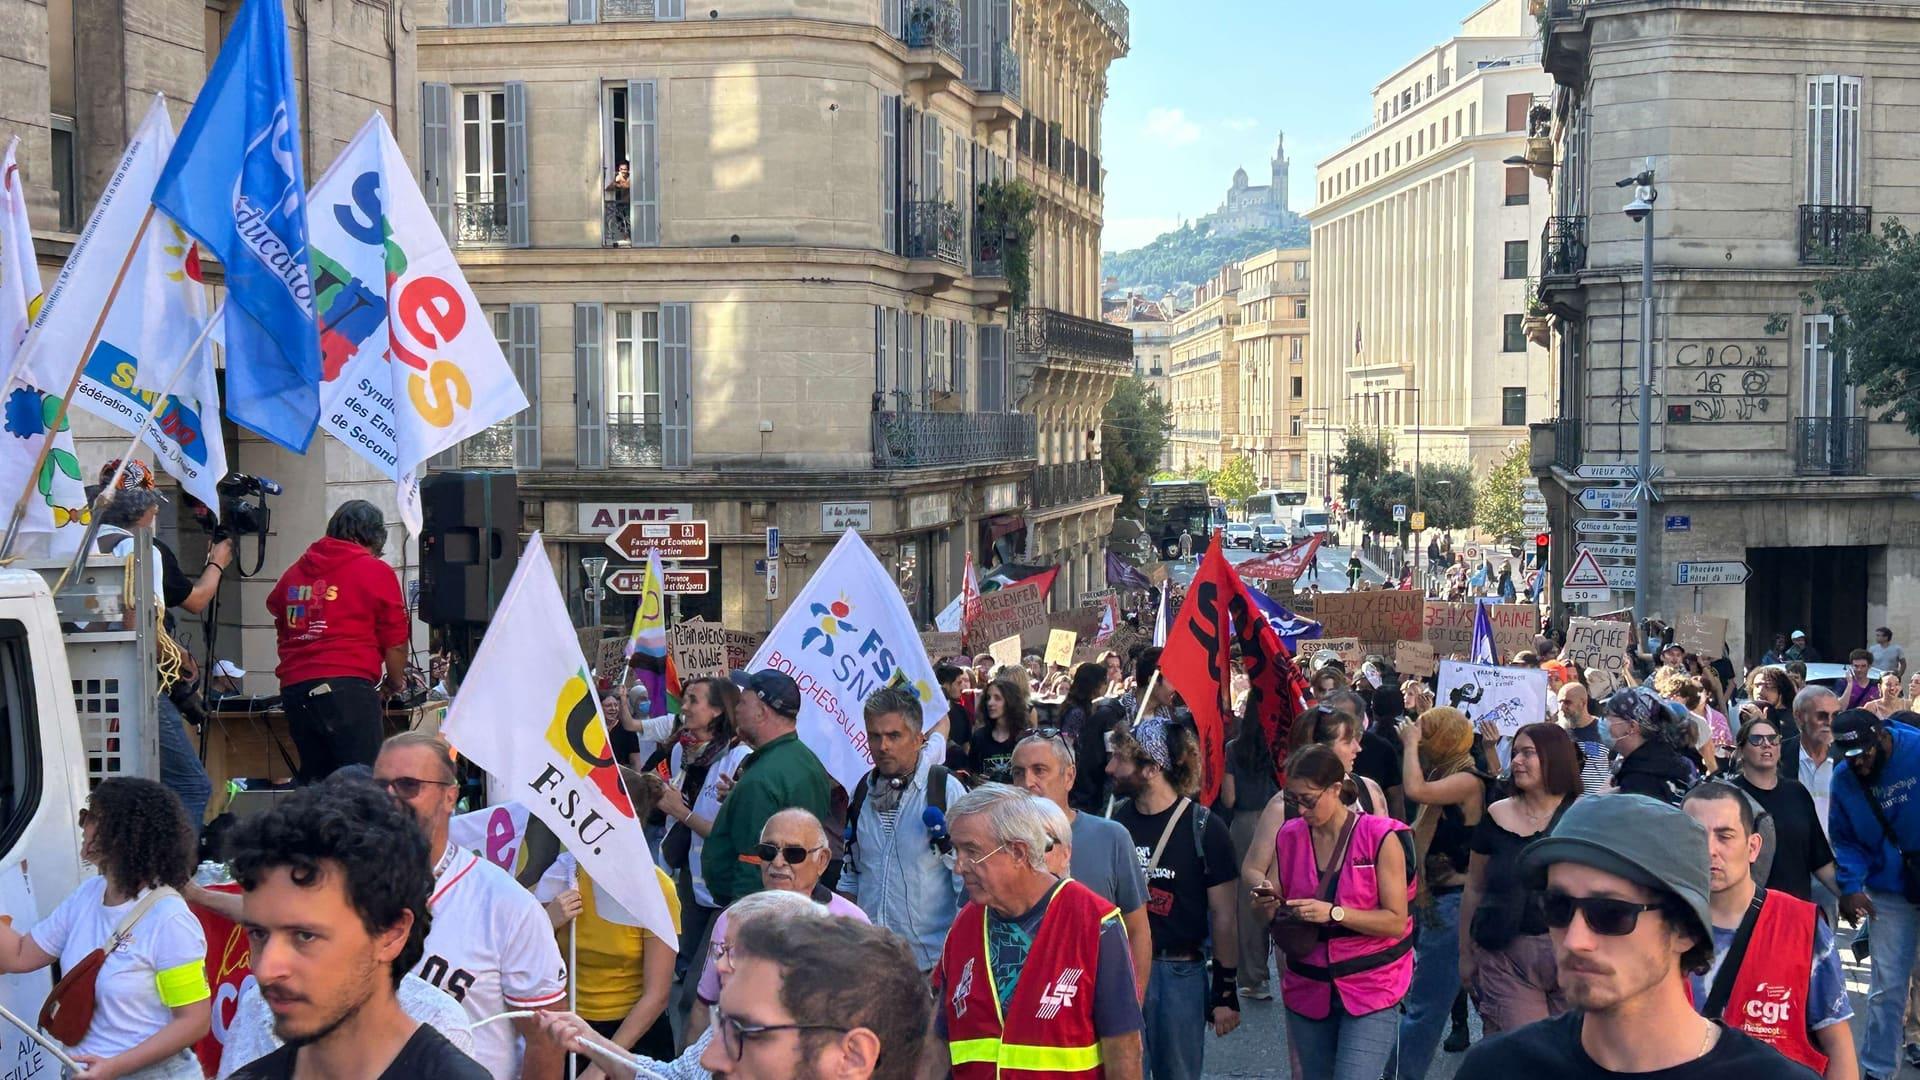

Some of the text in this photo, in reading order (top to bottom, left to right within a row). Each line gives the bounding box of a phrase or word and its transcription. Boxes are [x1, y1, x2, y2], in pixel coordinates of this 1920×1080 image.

[344, 396, 369, 418] des
[331, 413, 349, 430] de
[1591, 468, 1615, 476] VIEUX
[1581, 522, 1600, 530] Office
[1613, 523, 1637, 531] Tourism
[631, 537, 659, 546] Faculté
[631, 547, 639, 556] et
[1610, 546, 1619, 554] de
[1621, 546, 1637, 555] Post
[665, 574, 690, 582] Provence
[1575, 591, 1588, 599] 50
[1573, 627, 1626, 649] FACHÉE
[1568, 650, 1622, 670] FACHO
[832, 654, 874, 702] SN
[529, 763, 615, 855] F.S.U.
[1746, 1000, 1790, 1024] cgt
